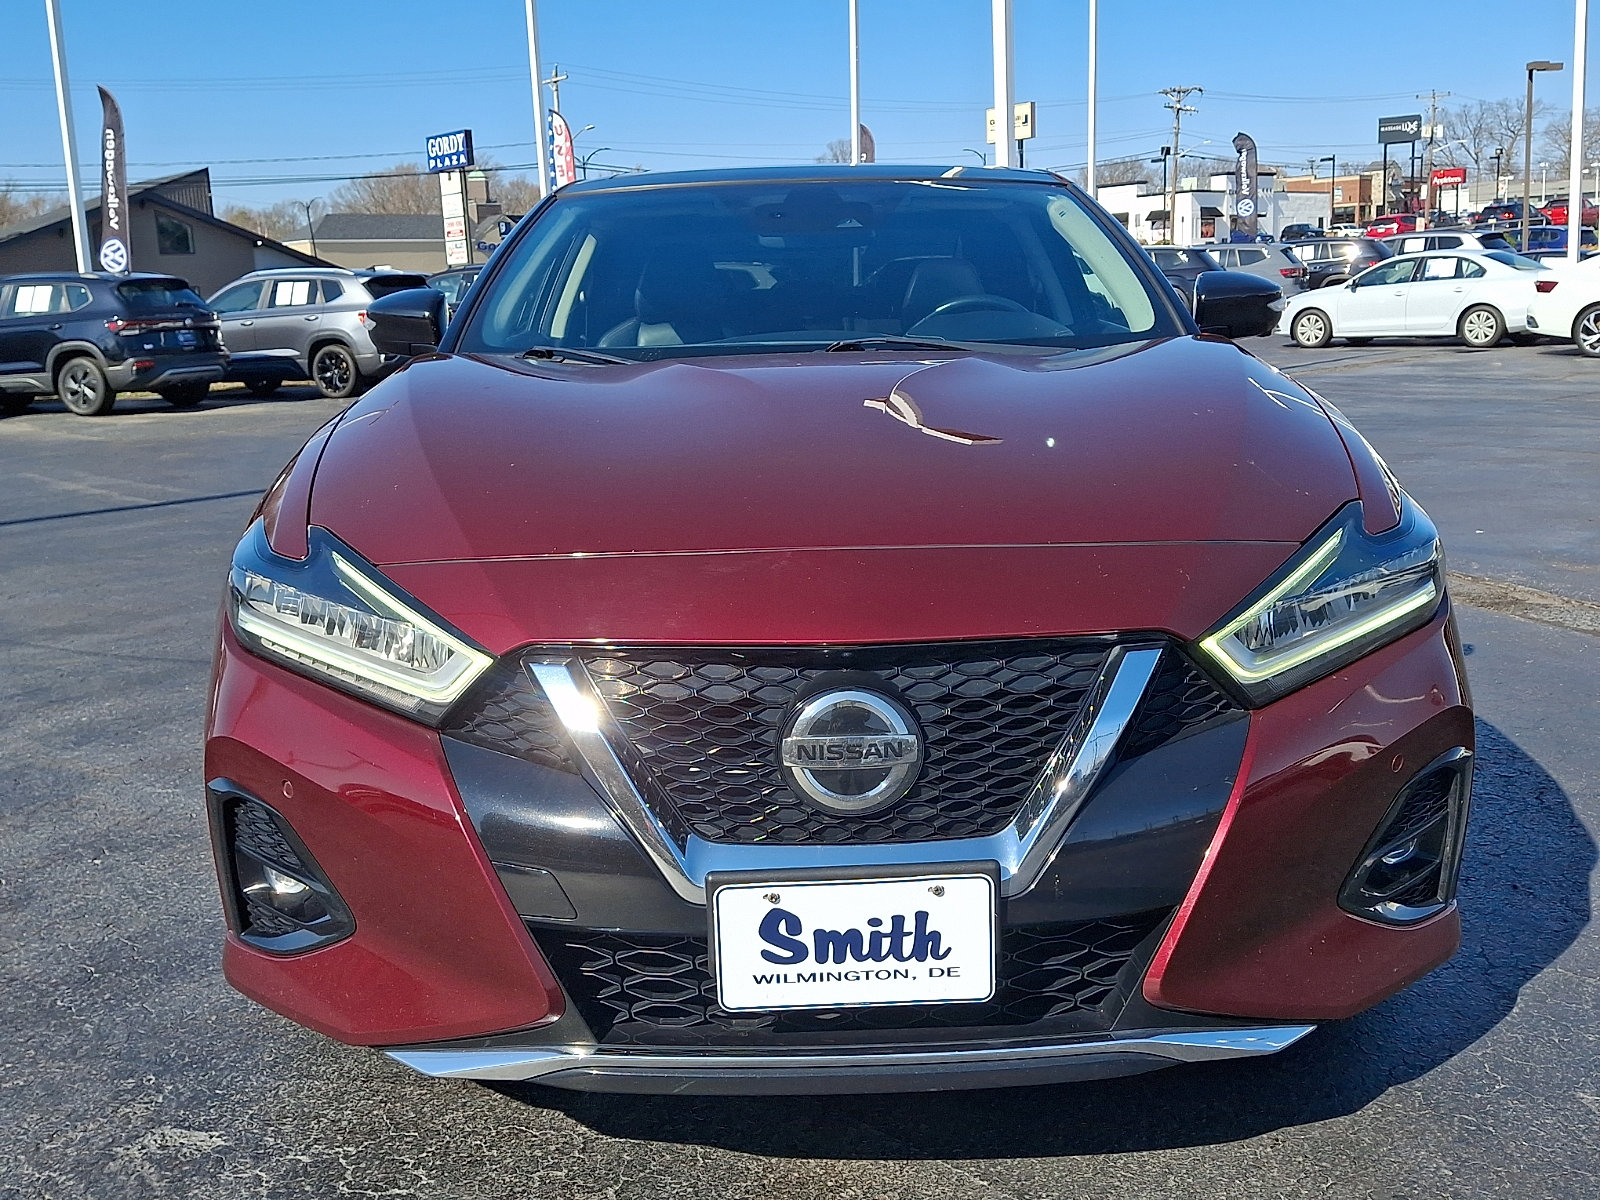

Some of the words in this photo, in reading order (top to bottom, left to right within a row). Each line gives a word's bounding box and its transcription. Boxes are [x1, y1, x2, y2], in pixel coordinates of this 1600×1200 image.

[428, 133, 465, 158] GORDY
[429, 154, 467, 170] PLAZA
[796, 741, 904, 762] NISSAN
[758, 907, 952, 965] Smith
[752, 968, 917, 985] WILMINGTON,
[928, 966, 961, 979] DE
